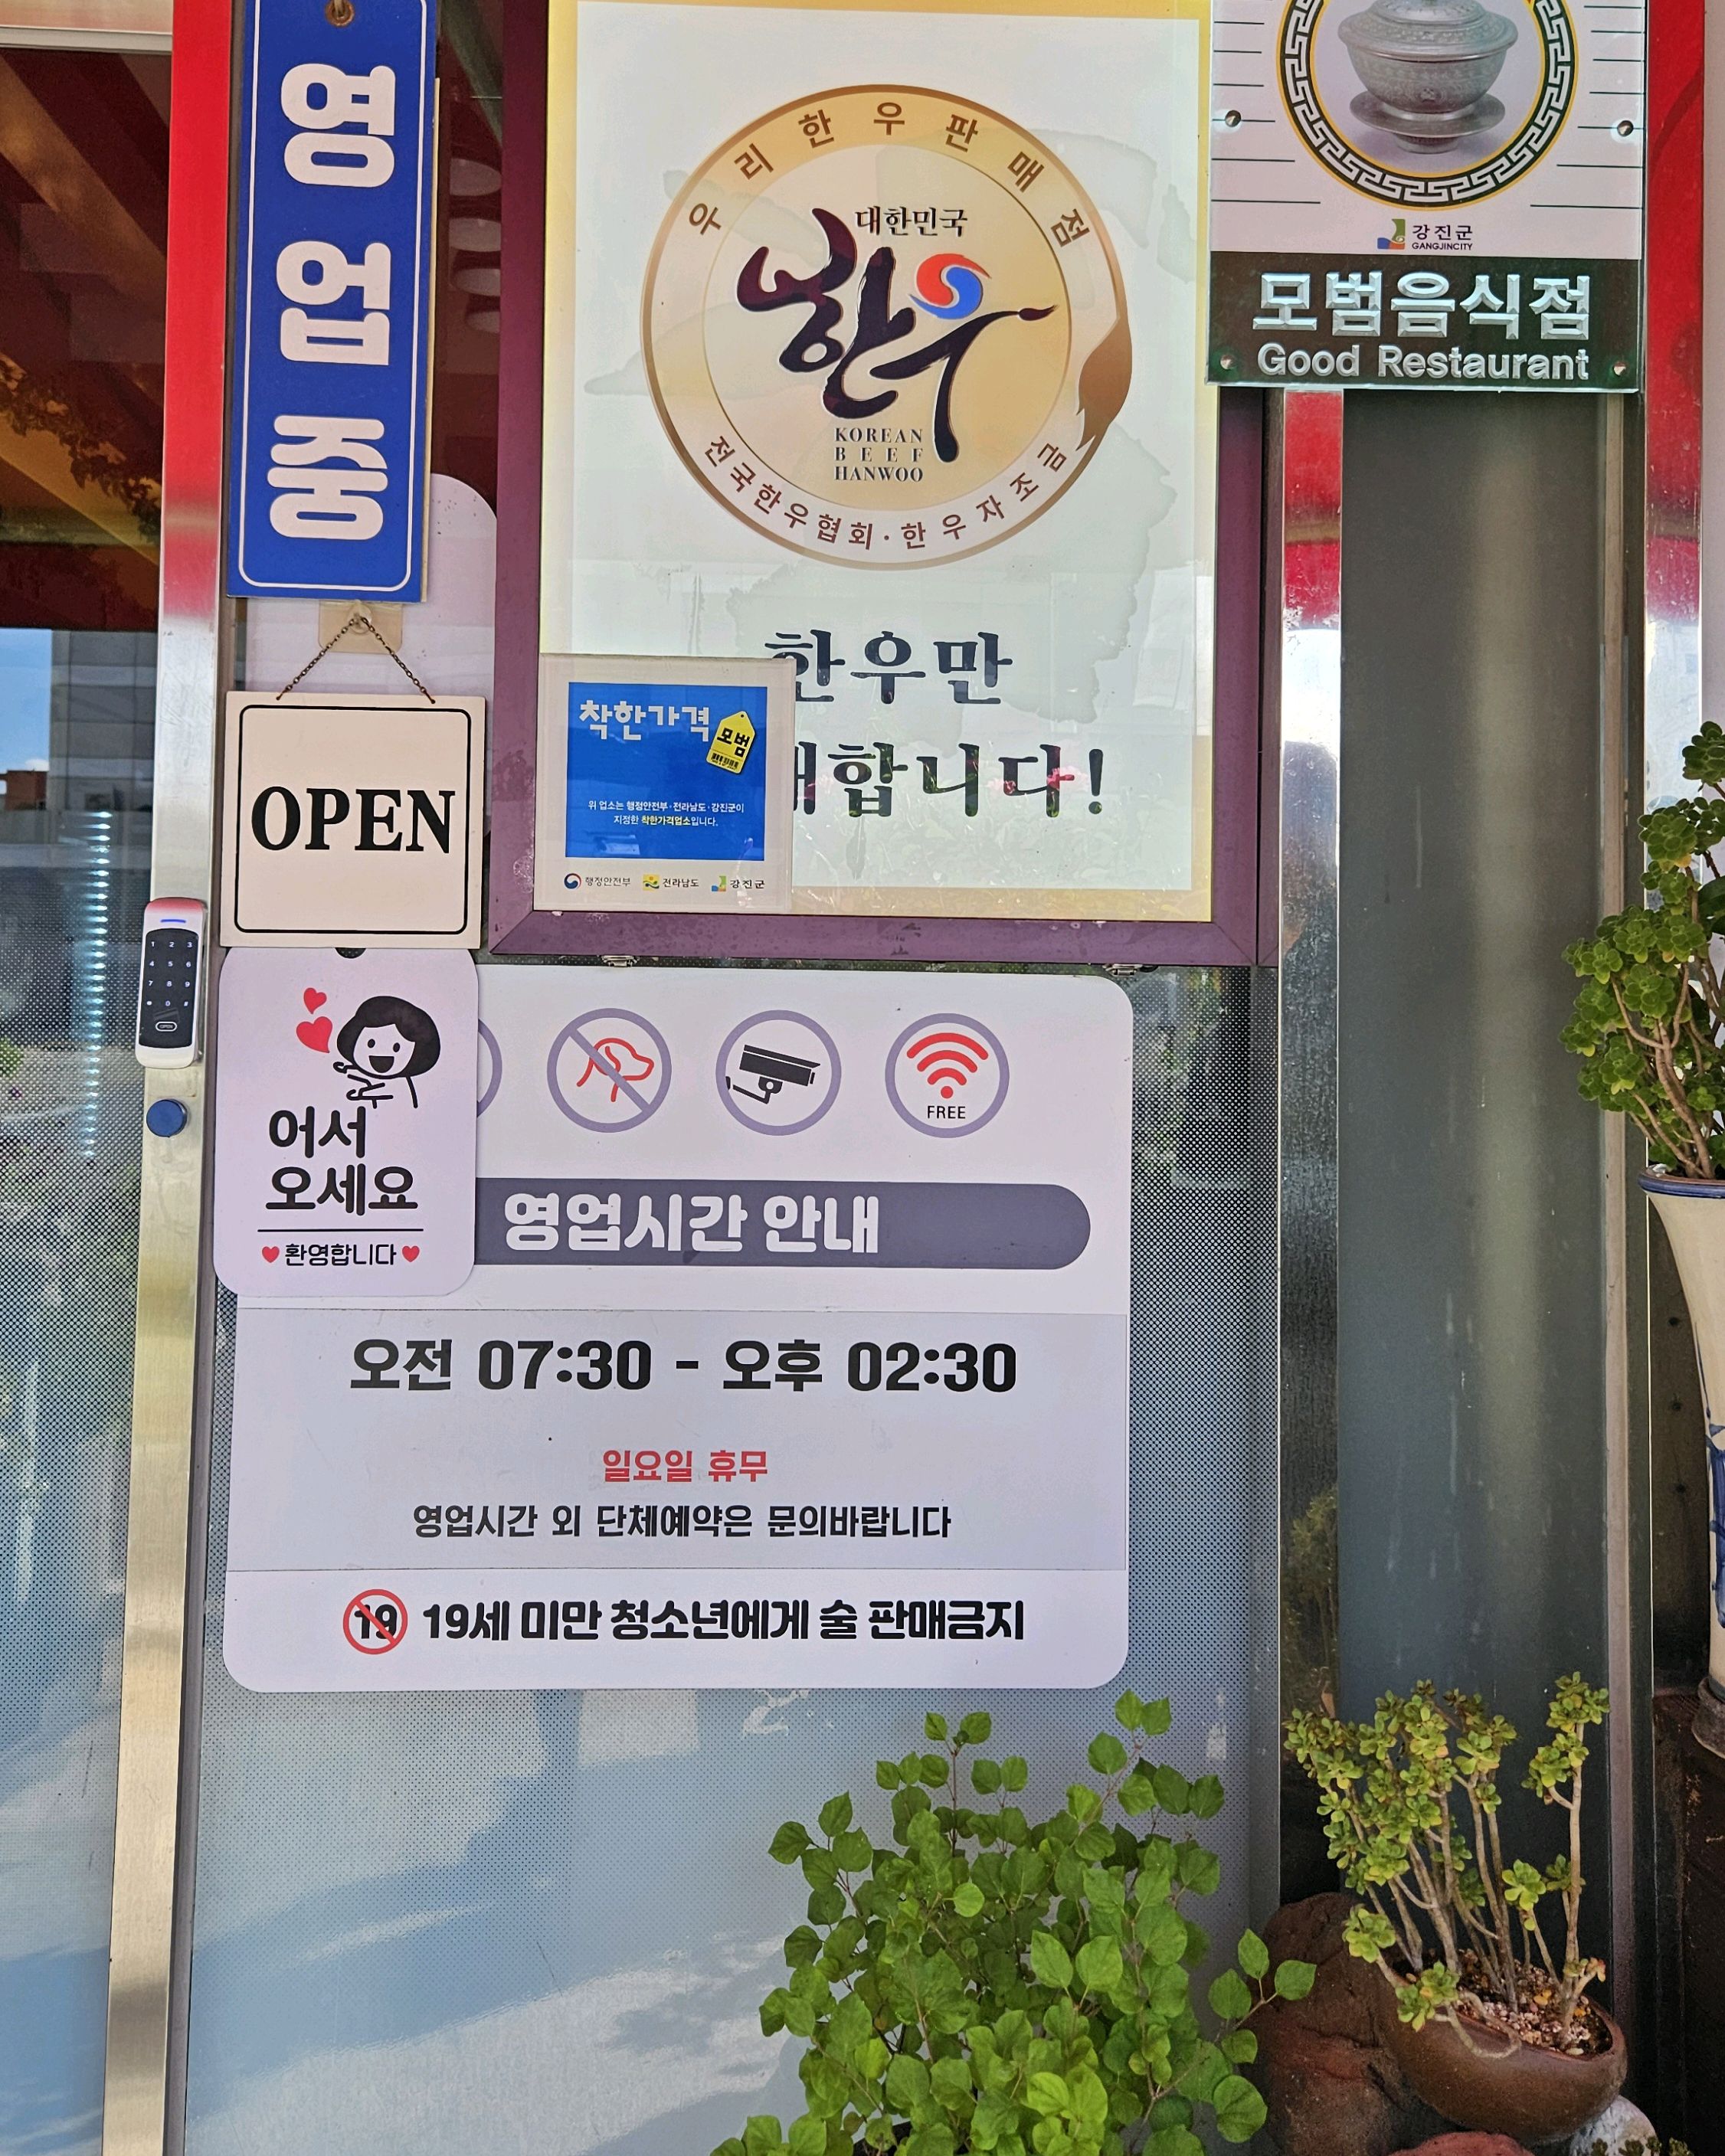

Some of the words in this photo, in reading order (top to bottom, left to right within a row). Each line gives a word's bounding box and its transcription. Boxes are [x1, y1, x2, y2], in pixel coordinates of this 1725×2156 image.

[856, 205, 968, 237] 대한민국
[1412, 224, 1473, 241] 강진군
[1412, 242, 1473, 250] GANGJINCITY
[268, 63, 396, 540] 영업중
[1252, 270, 1590, 340] 모범음식점
[1258, 342, 1360, 377] Good
[1379, 345, 1589, 381] Restaurant
[835, 427, 923, 443] KOREAN
[835, 447, 923, 463] BEEF
[835, 466, 924, 483] HANWOO
[764, 630, 1013, 704] 한우만
[578, 700, 709, 742] 착한가격
[717, 728, 750, 757] 모범
[251, 786, 456, 854] OPEN
[588, 800, 597, 810] 위
[599, 801, 624, 811] 업소는
[614, 815, 639, 825] 지정한
[585, 877, 630, 887] 행정안전부
[663, 878, 699, 888] 전라남도
[730, 879, 765, 888] 강진군
[927, 1105, 966, 1120] FREE
[269, 1106, 365, 1158] 어서
[266, 1163, 418, 1216] 오세요
[504, 1193, 748, 1252] 영업시간
[765, 1196, 879, 1254] 안내
[285, 1243, 397, 1267] 환영합니다
[350, 1339, 452, 1391] 오전
[479, 1340, 651, 1390] 07:30
[723, 1339, 823, 1392] 오후
[848, 1341, 1016, 1392] 02:30
[603, 1450, 692, 1483] 일요일
[708, 1450, 768, 1483] 휴무
[414, 1505, 538, 1537] 영업시간
[552, 1505, 581, 1537] 외
[597, 1505, 752, 1537] 단체예약은
[768, 1506, 951, 1538] 문의바랍니다
[424, 1601, 510, 1641] 19세
[521, 1600, 602, 1640] 미만
[611, 1599, 808, 1640] 청소년에게
[820, 1599, 858, 1640] 술
[869, 1600, 1024, 1640] 판매금지
